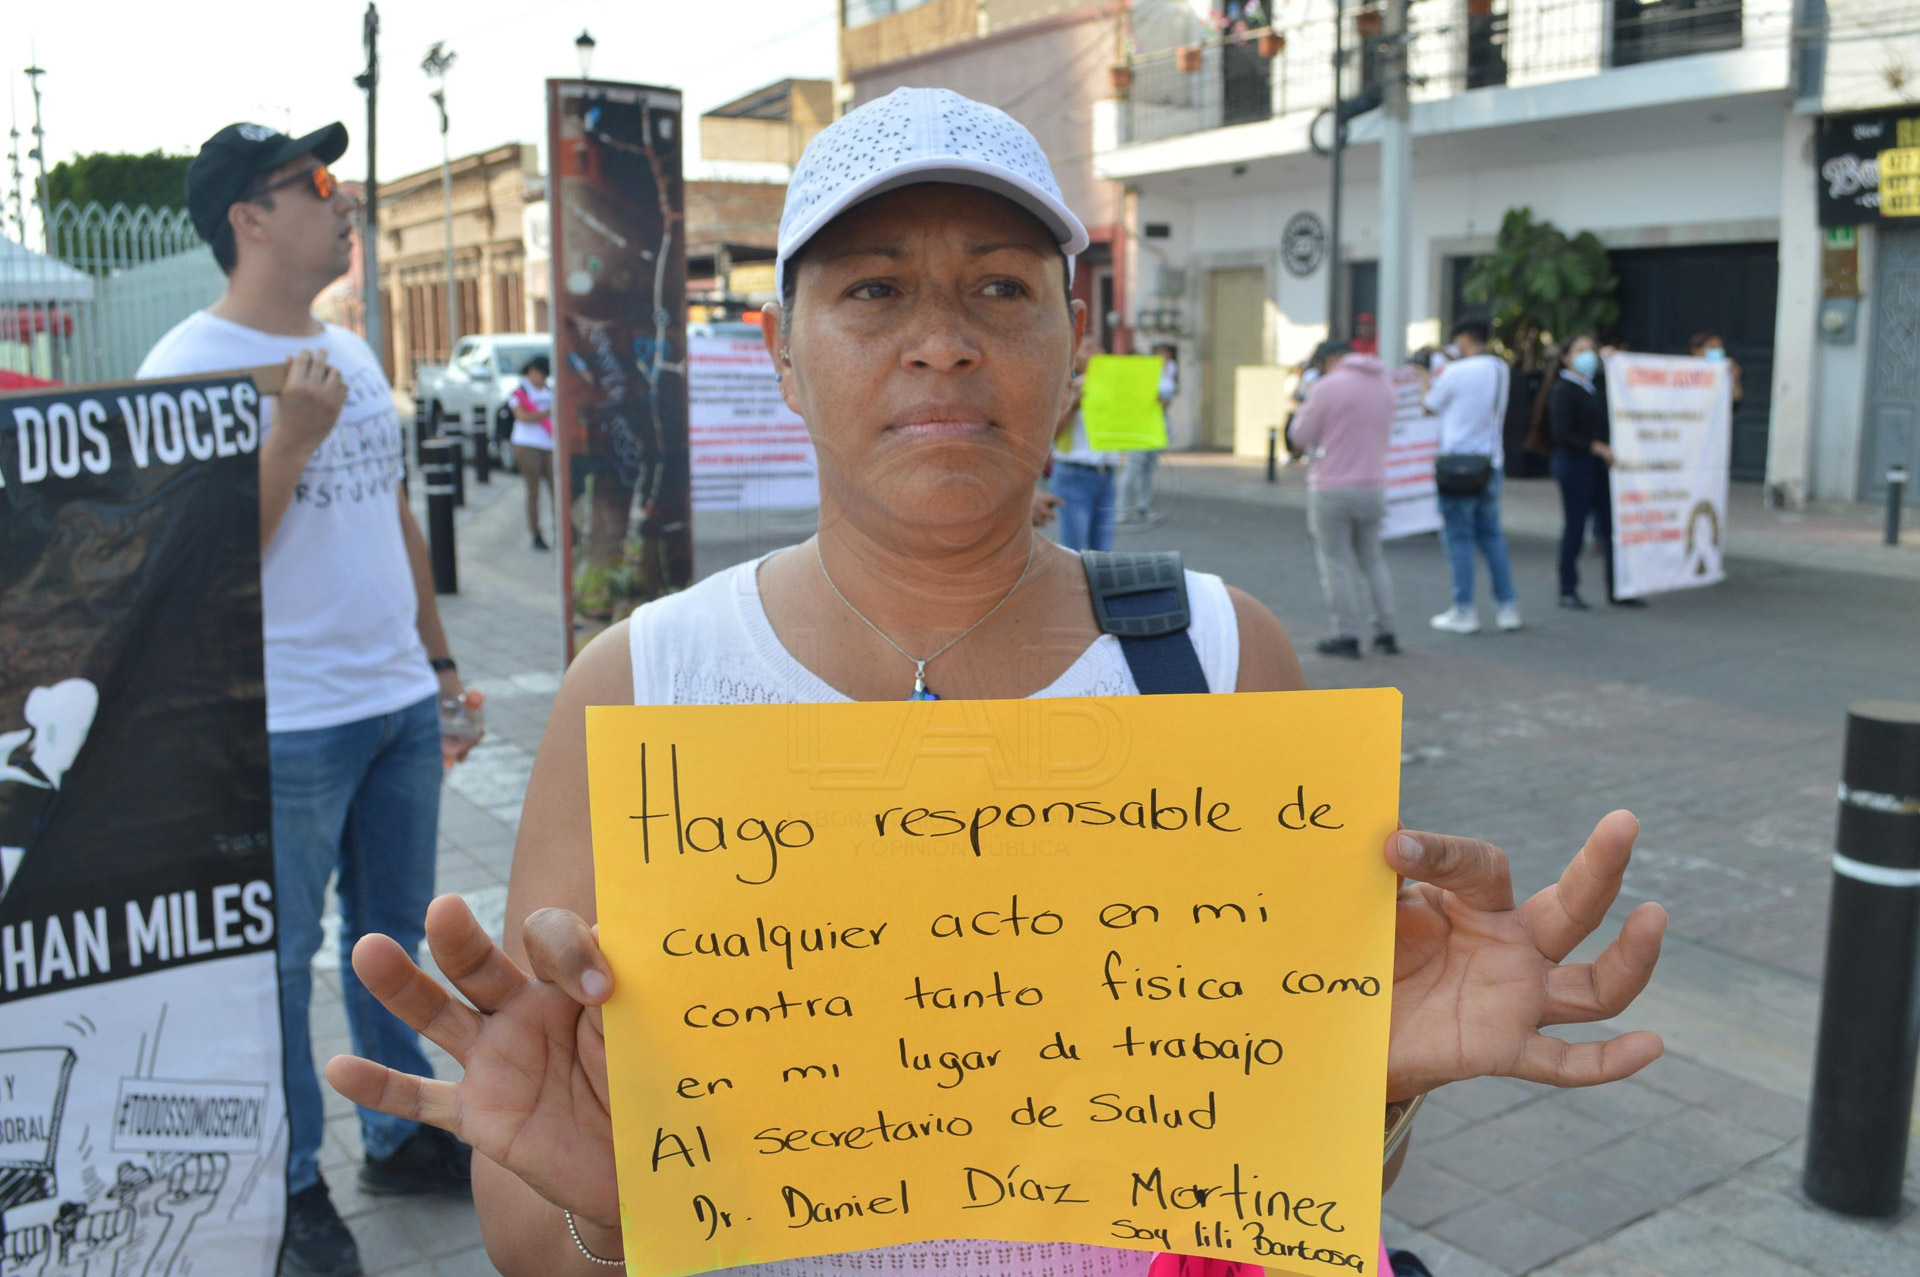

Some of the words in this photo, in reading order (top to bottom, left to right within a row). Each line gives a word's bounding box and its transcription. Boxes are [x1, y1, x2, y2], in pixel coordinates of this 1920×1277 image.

[12, 399, 111, 484] DOS
[116, 382, 259, 469] VOCES
[630, 743, 814, 884] Hago
[876, 787, 1242, 856] responsable
[1278, 785, 1344, 829] de
[0, 906, 111, 992] HAN
[125, 880, 274, 967] MILES
[663, 918, 887, 969] cualquier
[932, 895, 1062, 937] acto
[1100, 903, 1159, 929] en
[1193, 893, 1267, 924] mi
[684, 991, 853, 1027] contra
[905, 972, 1043, 1008] tanto
[1101, 951, 1243, 1000] fisica
[1282, 971, 1380, 997] como
[4, 1075, 15, 1101] Y
[677, 1077, 733, 1098] en
[783, 1064, 839, 1083] mi
[900, 1038, 1001, 1088] lugar
[1040, 1032, 1081, 1060] de
[1113, 1027, 1283, 1075] trabajo
[652, 1126, 711, 1172] Al
[754, 1111, 973, 1154] secretario
[1011, 1097, 1063, 1127] de
[1090, 1092, 1216, 1129] Salud
[693, 1195, 752, 1240] Dr.
[782, 1180, 909, 1228] Daniel
[963, 1165, 1089, 1208] Díaz
[1132, 1163, 1344, 1233] Martinez
[1112, 1220, 1170, 1249] Soy
